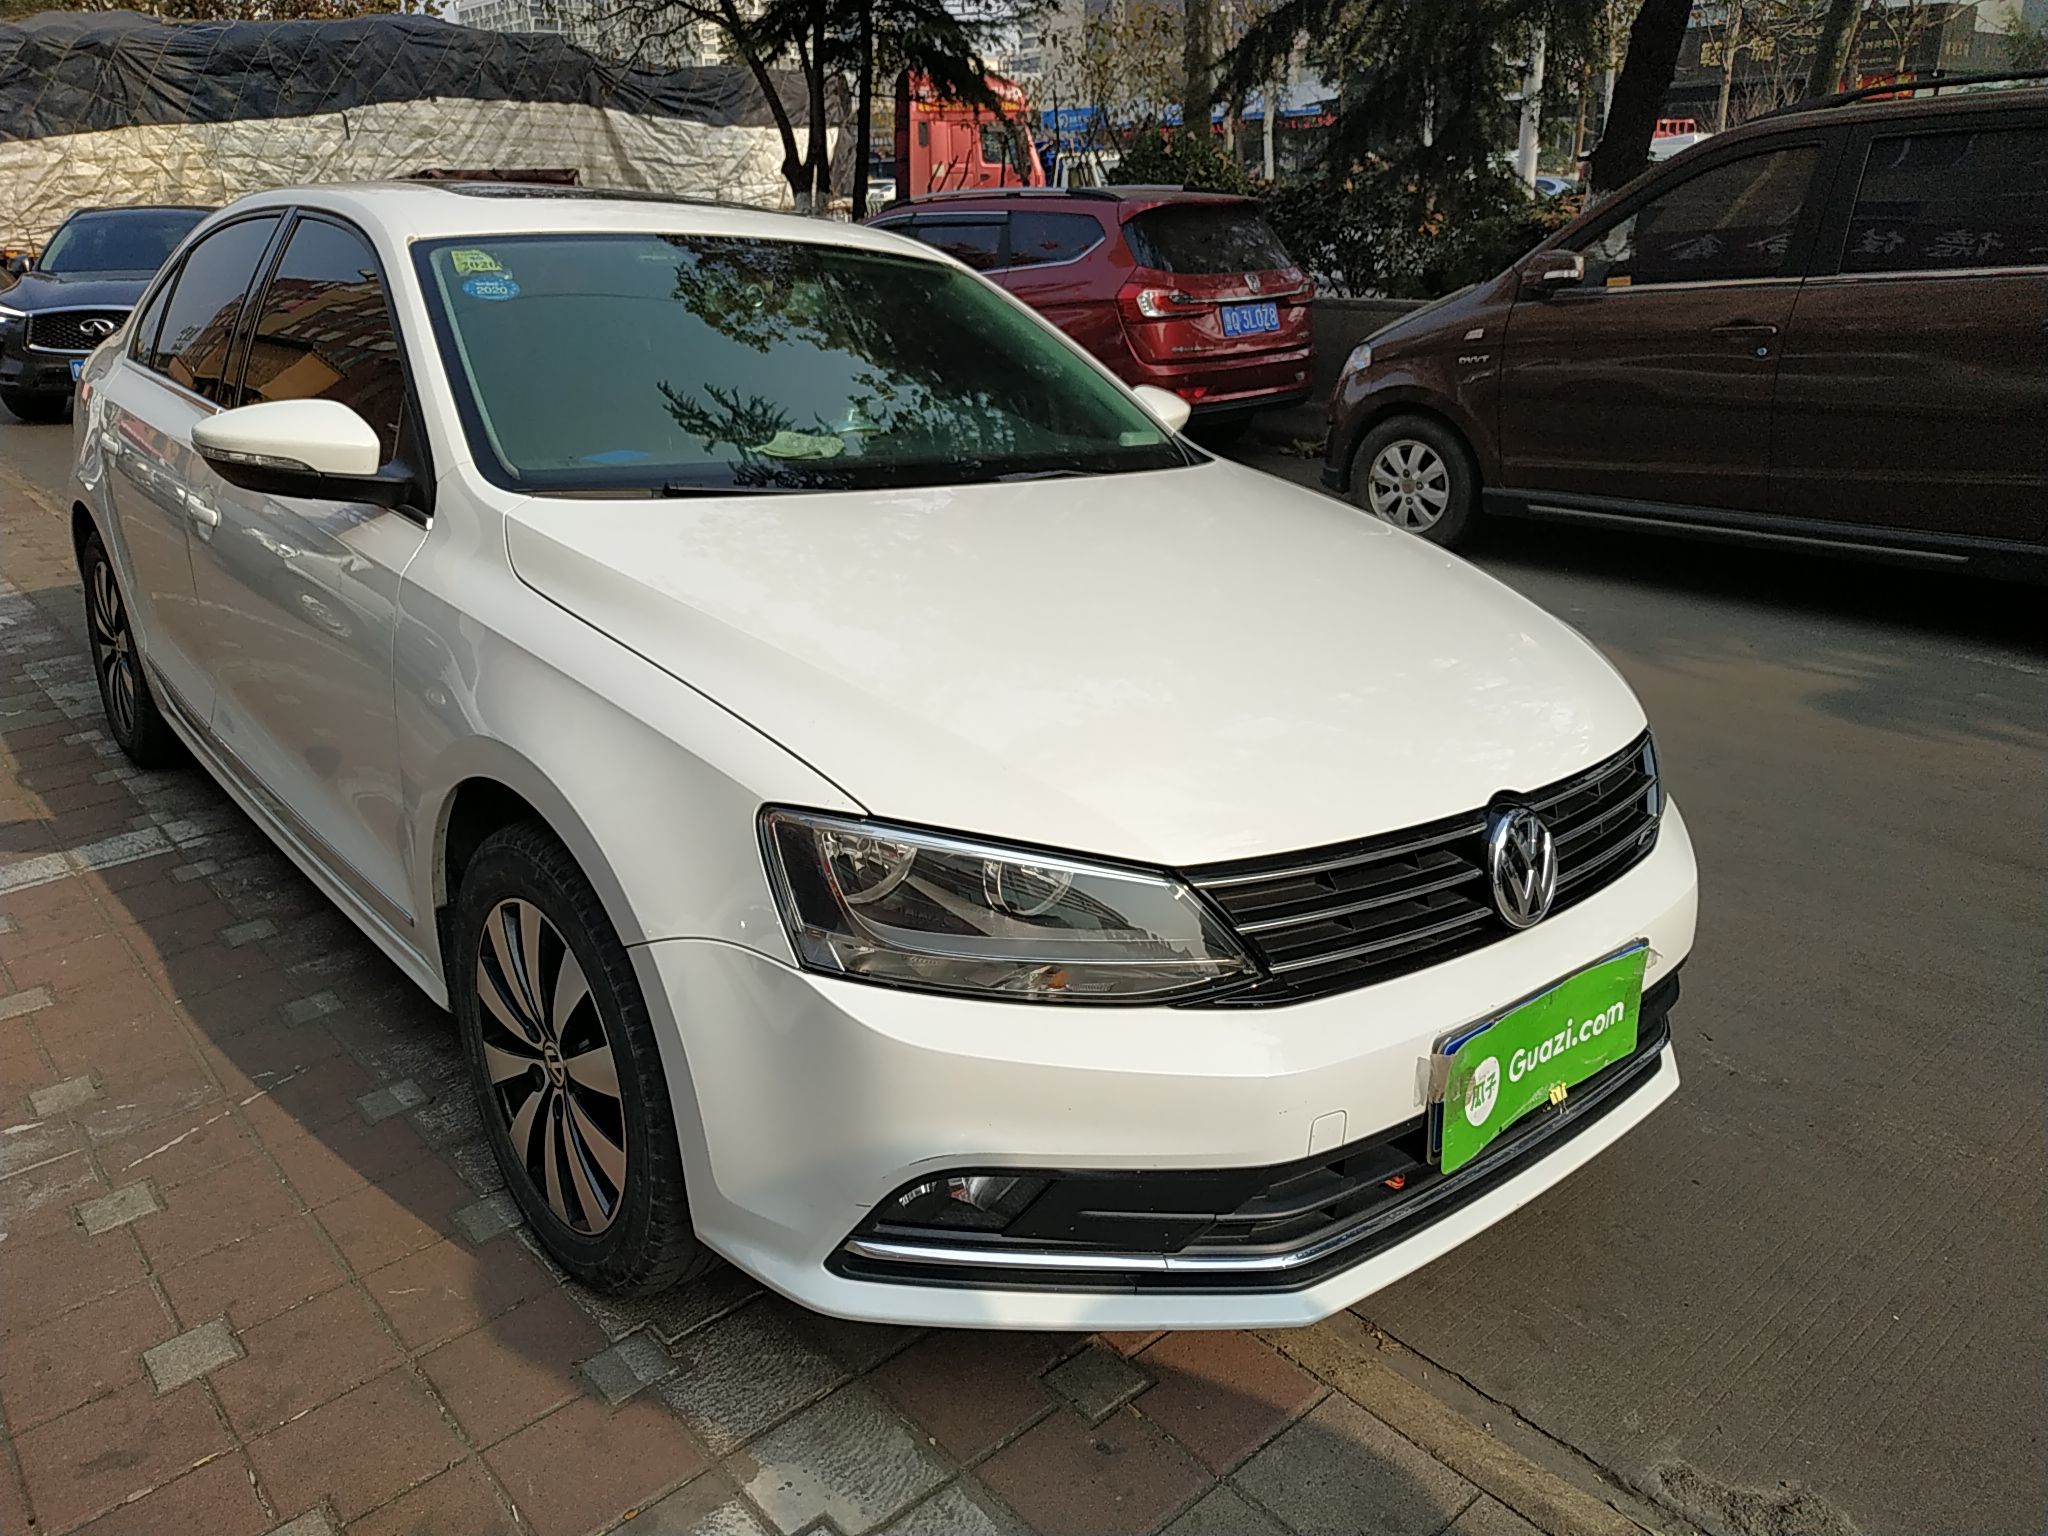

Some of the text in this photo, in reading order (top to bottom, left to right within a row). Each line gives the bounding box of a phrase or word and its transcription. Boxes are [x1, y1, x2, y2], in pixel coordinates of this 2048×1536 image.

[476, 286, 508, 295] 2020
[1508, 1001, 1625, 1083] Guazi.com
[1470, 1073, 1497, 1113] 瓜子
